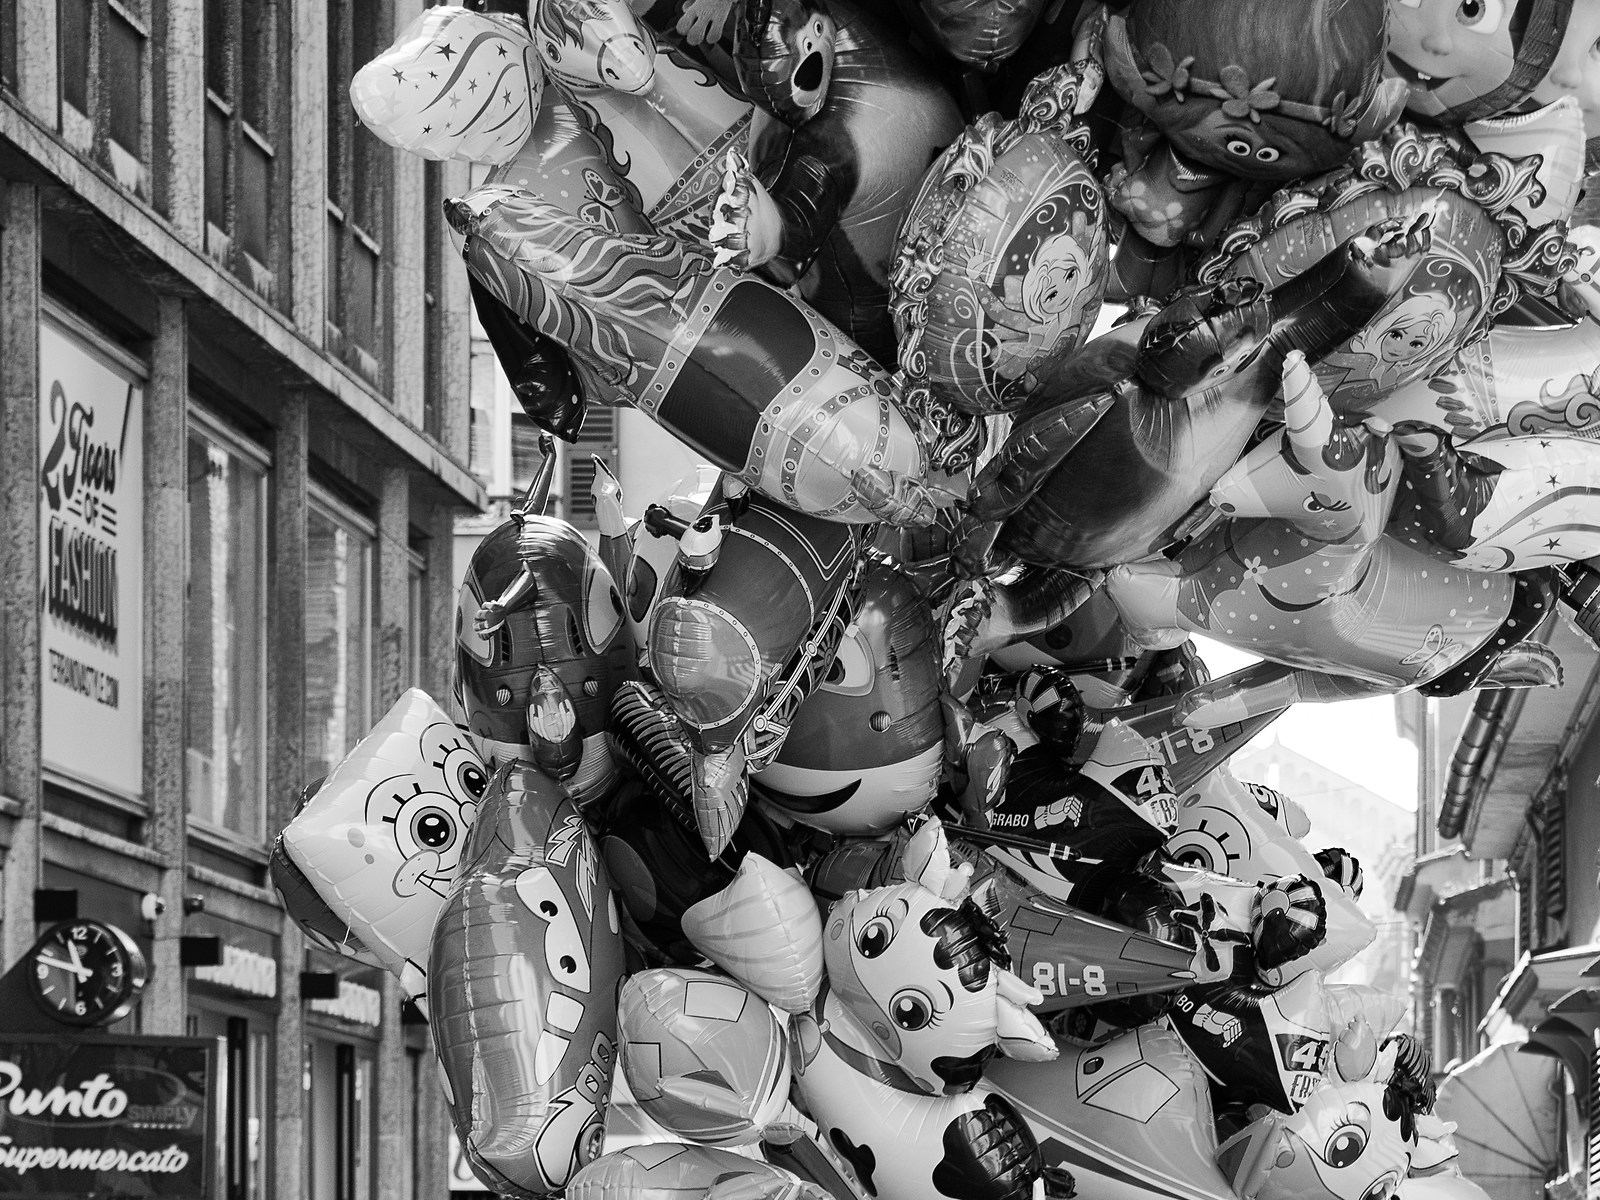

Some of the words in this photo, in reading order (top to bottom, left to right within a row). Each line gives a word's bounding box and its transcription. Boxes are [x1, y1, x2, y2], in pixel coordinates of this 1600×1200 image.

[42, 380, 66, 512] 2
[84, 492, 99, 526] OF
[48, 516, 119, 646] FASHION
[988, 812, 1030, 827] GRABO
[71, 926, 87, 940] 12
[37, 963, 49, 980] 9
[111, 962, 123, 977] 3
[1032, 961, 1108, 997] 81-8
[75, 1001, 87, 1016] 6
